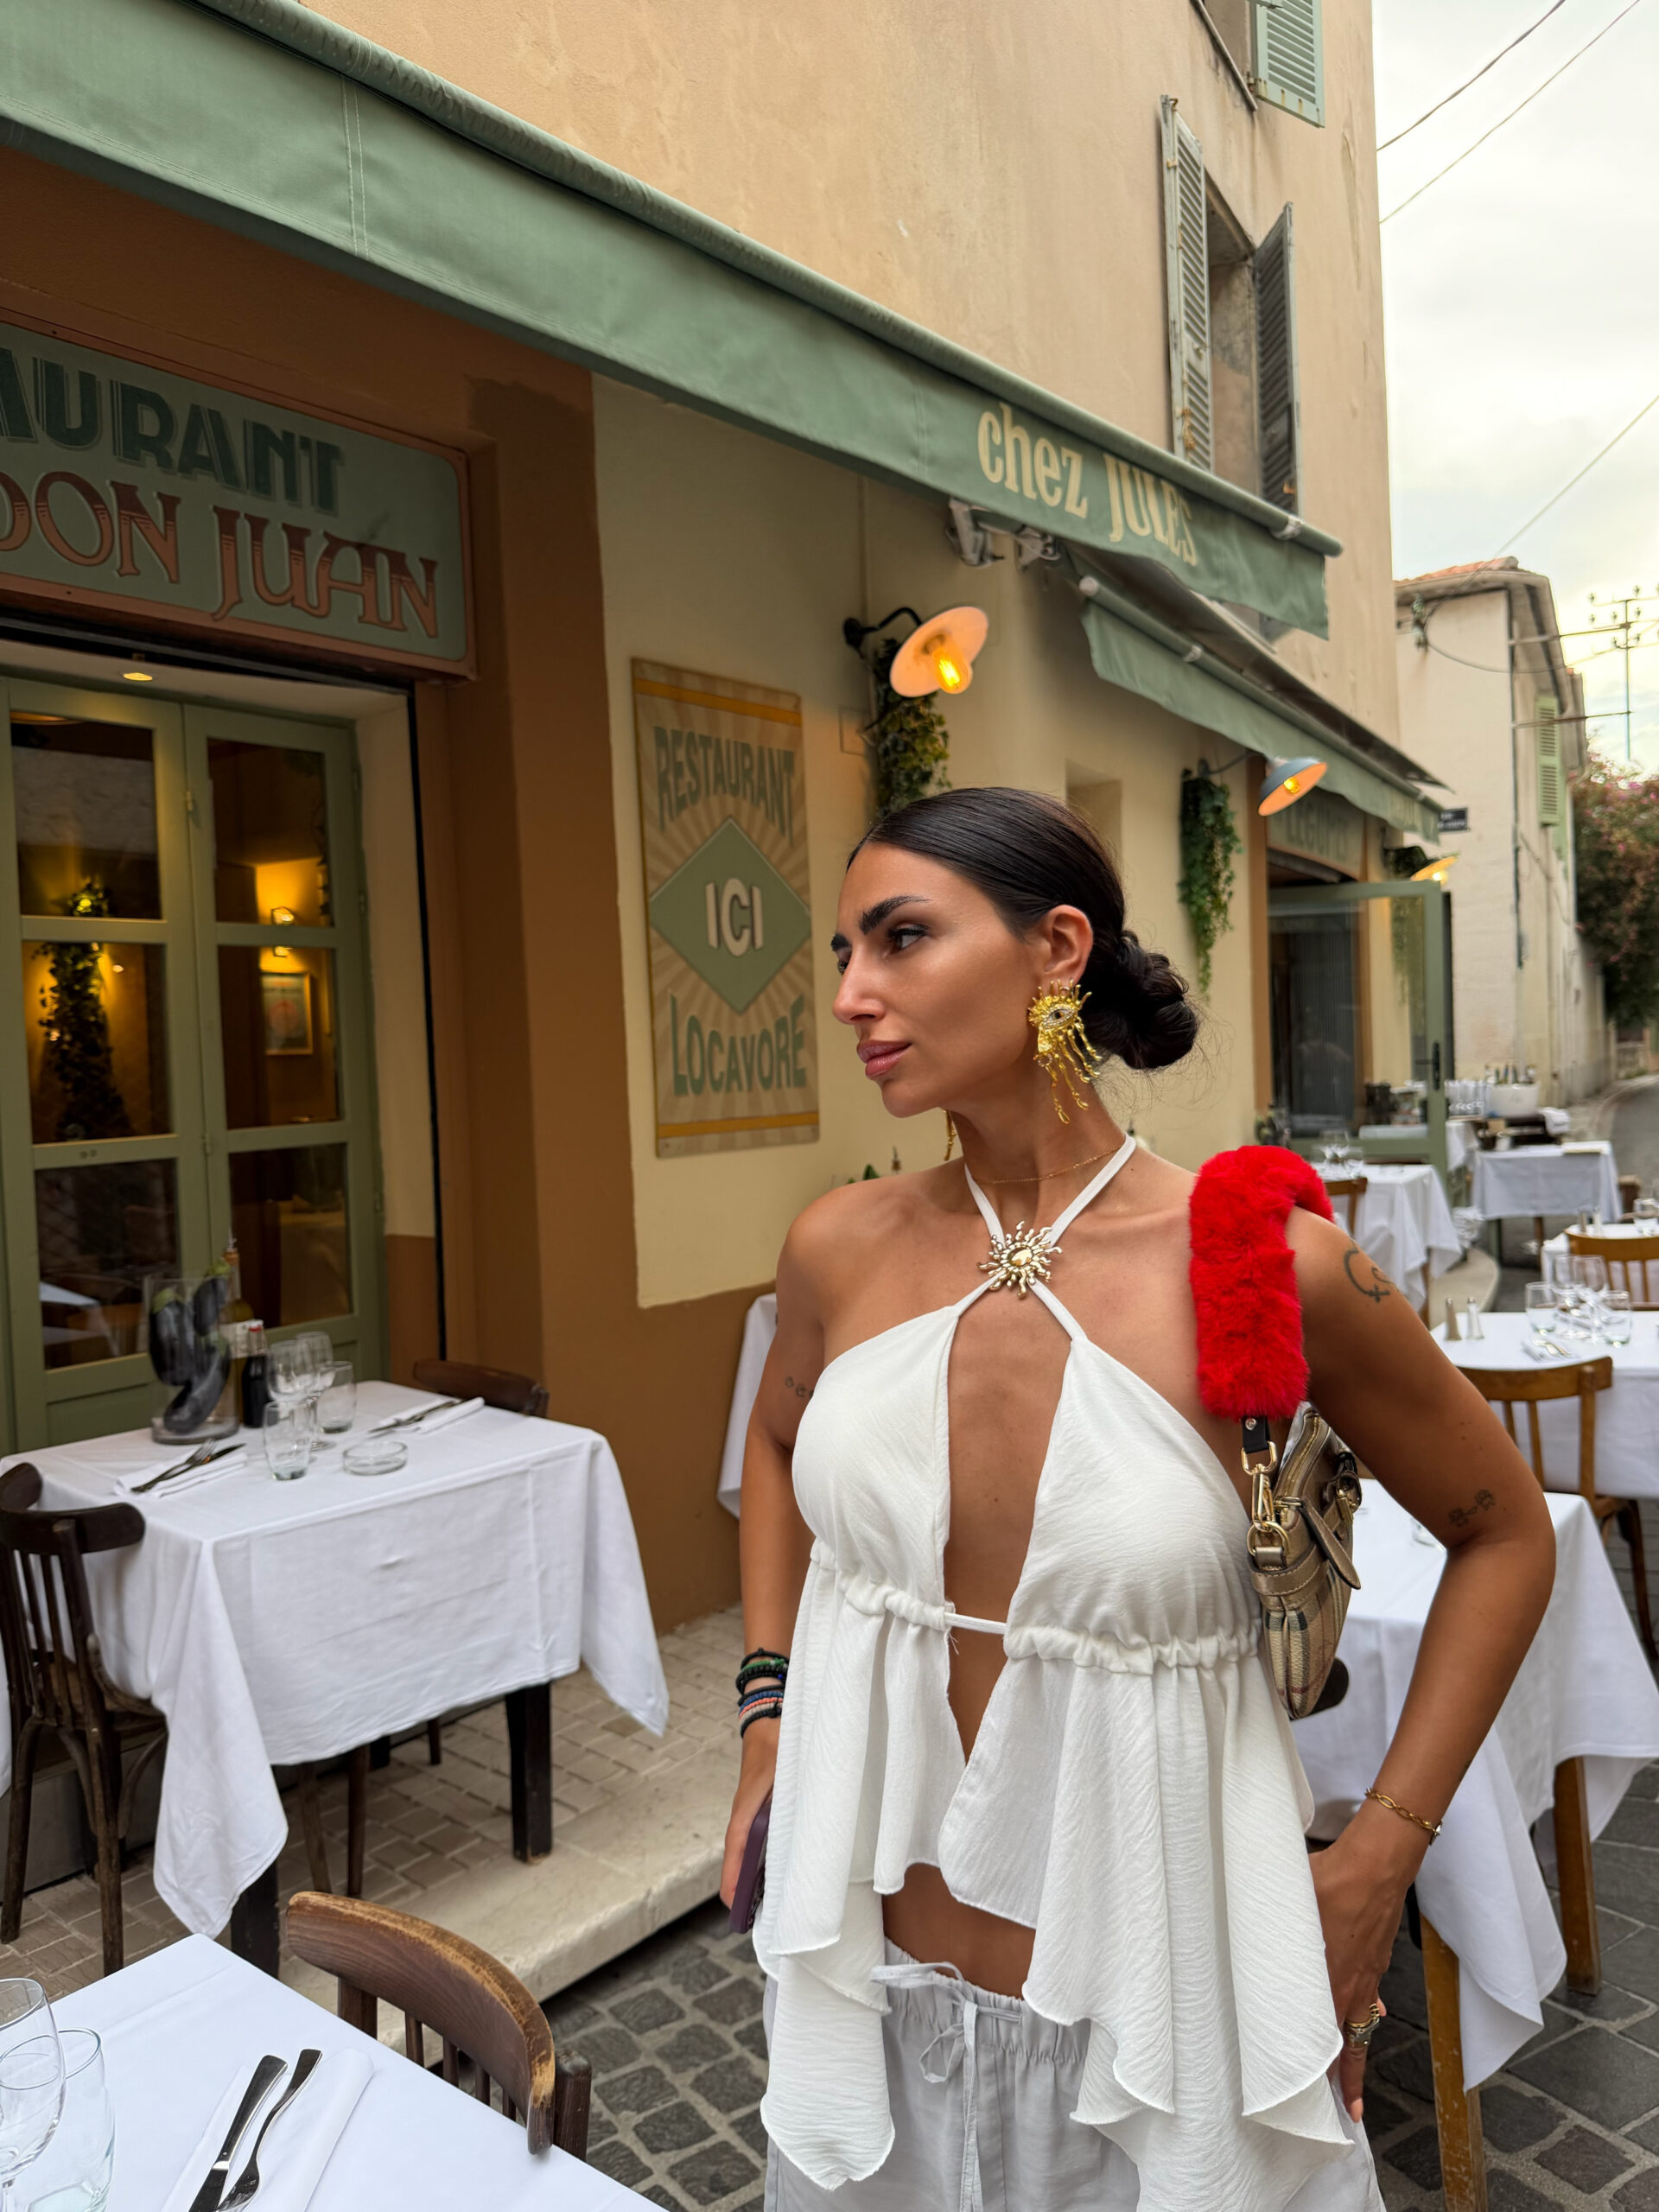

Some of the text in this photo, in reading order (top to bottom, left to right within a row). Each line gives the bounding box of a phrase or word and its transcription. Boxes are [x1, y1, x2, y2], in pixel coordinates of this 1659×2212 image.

[977, 403, 1197, 566] chez JULES
[212, 505, 438, 639] JUAN
[654, 726, 795, 846] RESTAURANT
[705, 878, 763, 957] ICI
[669, 988, 807, 1096] LOCAVORE
